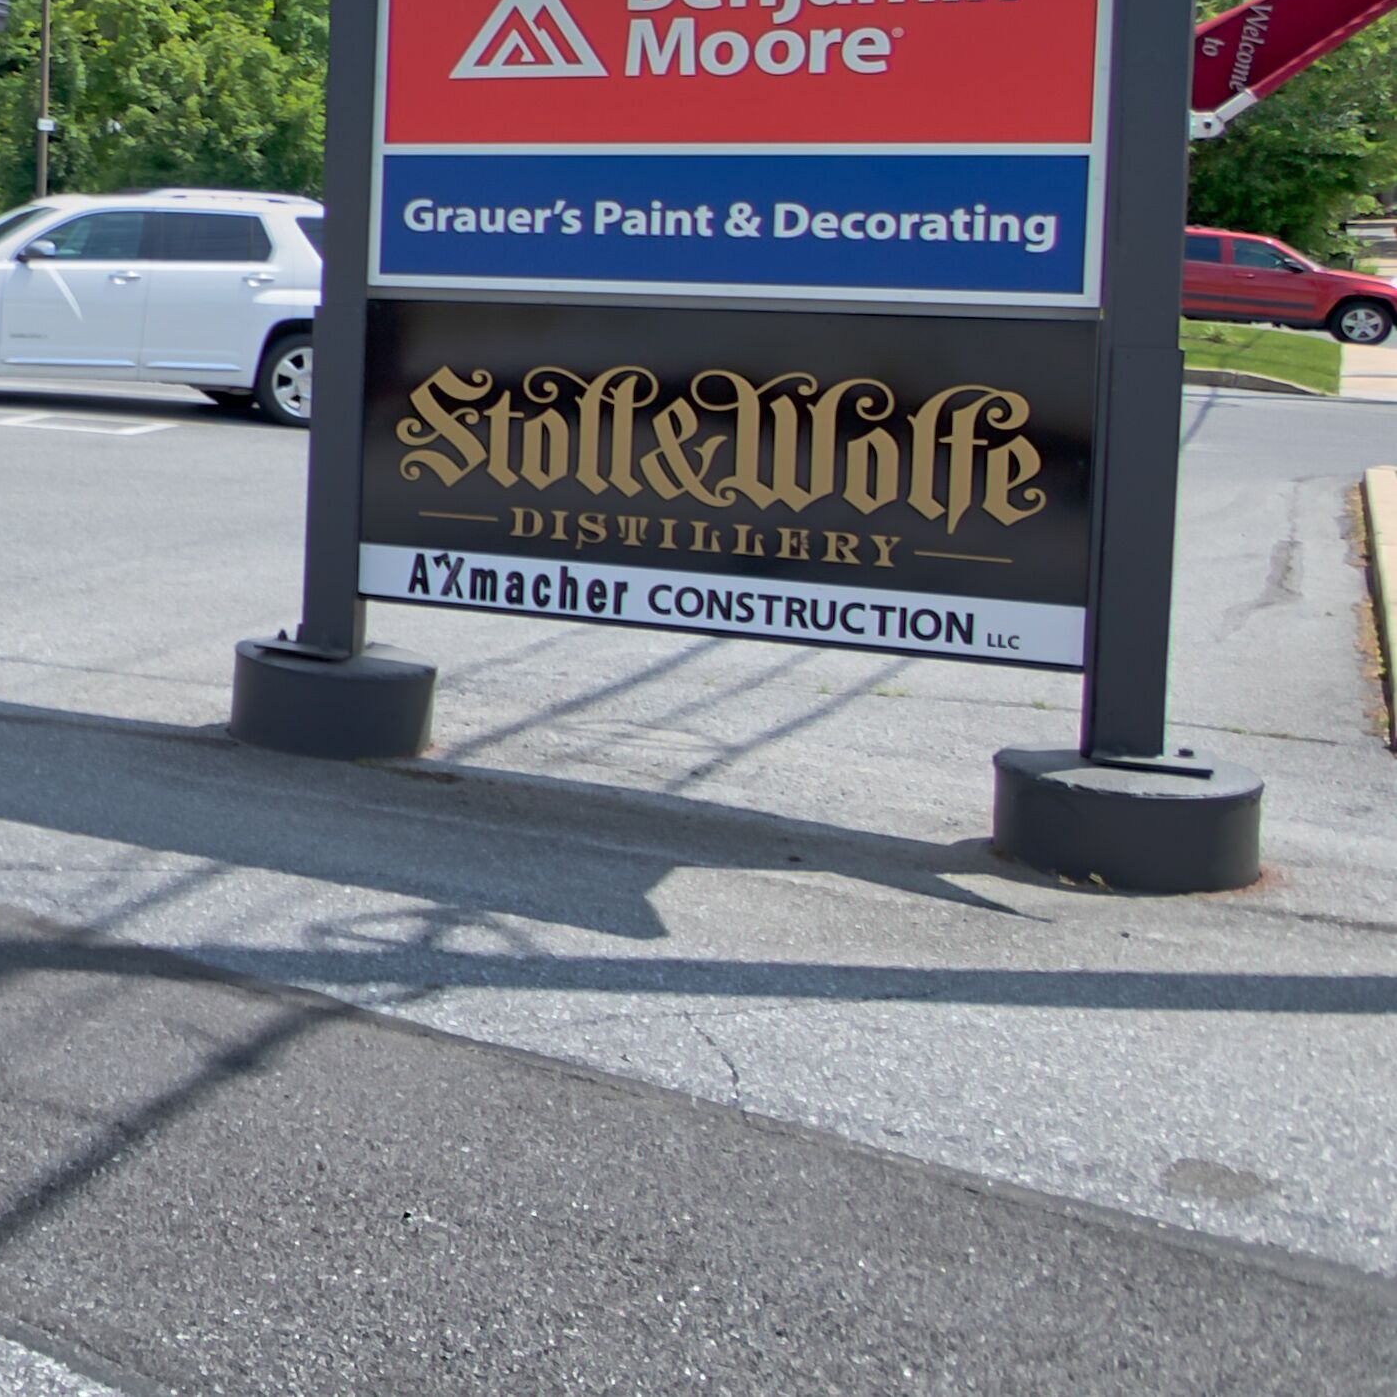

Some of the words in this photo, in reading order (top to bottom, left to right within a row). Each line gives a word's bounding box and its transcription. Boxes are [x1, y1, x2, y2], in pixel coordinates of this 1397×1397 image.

[1201, 37, 1225, 57] to
[1228, 5, 1274, 93] Welcome
[402, 197, 583, 236] Grauer's
[594, 199, 714, 238] Paint
[724, 203, 762, 240] &
[774, 203, 1058, 254] Decorating
[509, 506, 902, 567] DISTILLERY
[647, 583, 975, 645] CONSTRUCTION
[986, 633, 1021, 650] LLC
